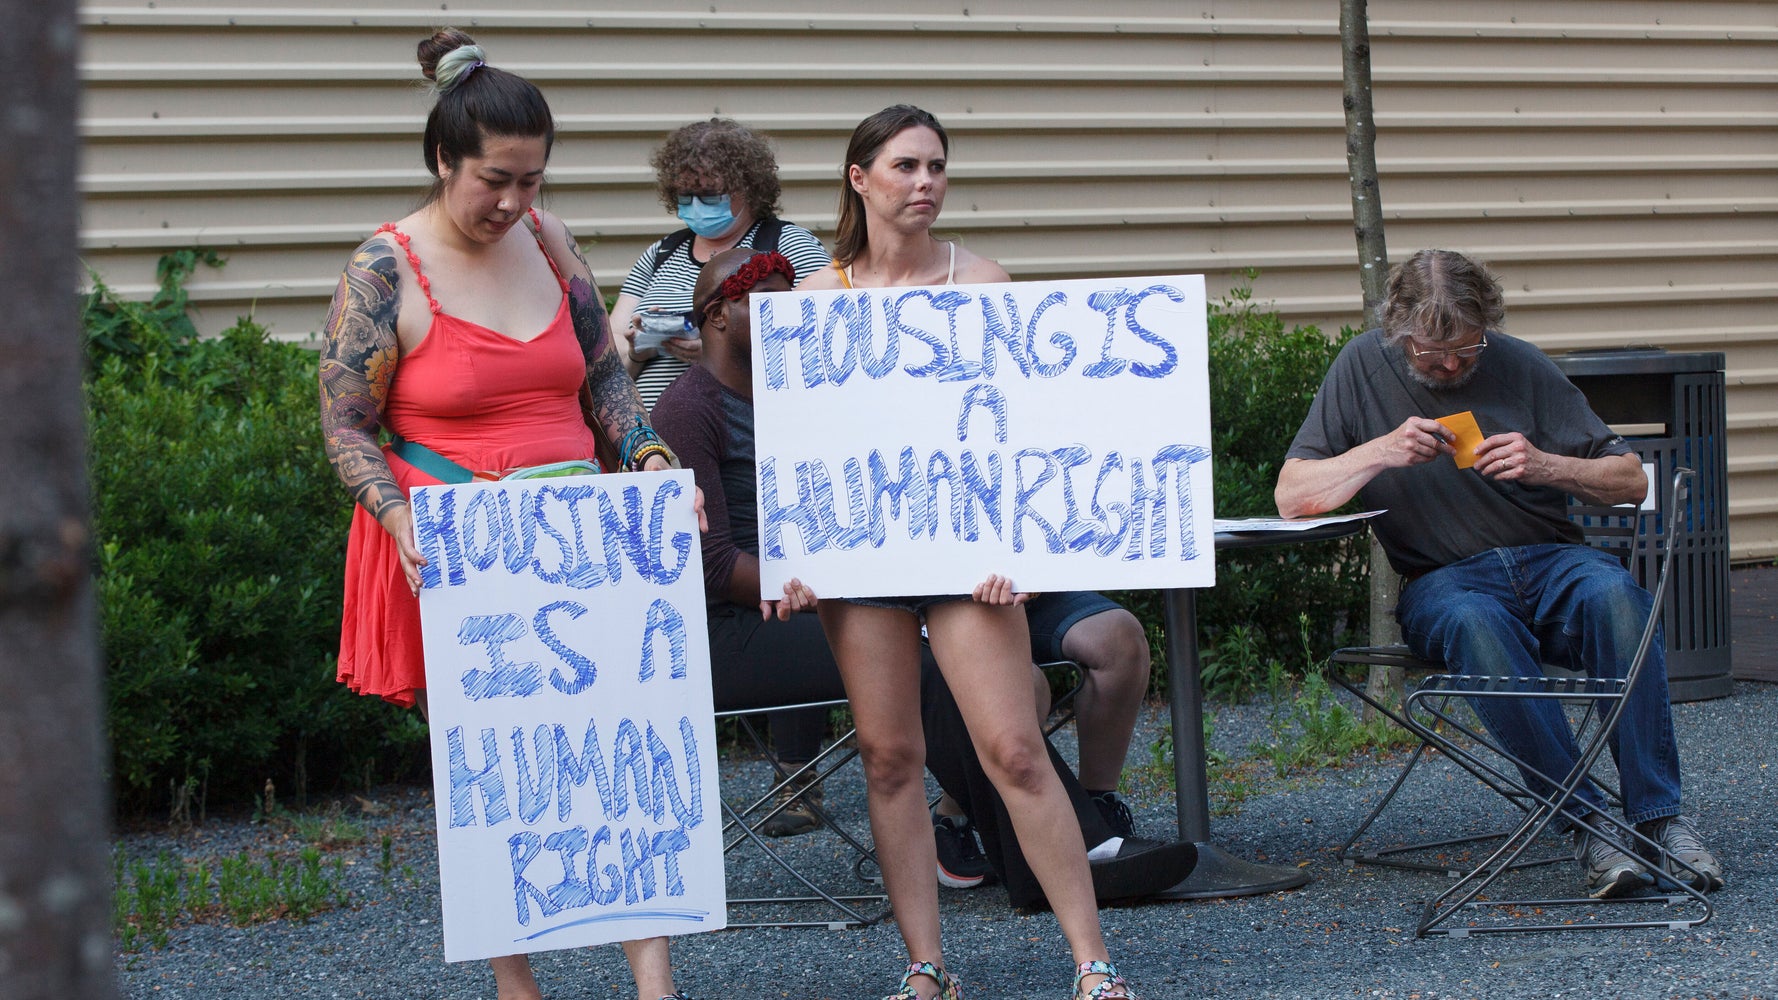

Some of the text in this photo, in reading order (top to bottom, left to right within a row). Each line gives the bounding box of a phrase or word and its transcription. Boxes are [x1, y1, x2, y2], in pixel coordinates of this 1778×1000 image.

[758, 285, 1186, 391] HOUSING IS
[957, 383, 1008, 444] A
[413, 480, 692, 590] HOUSING
[759, 443, 1211, 562] HUMAN RIGHT
[457, 598, 687, 701] IS A
[445, 716, 703, 829] HUMAN
[508, 825, 690, 926] RIGHT
